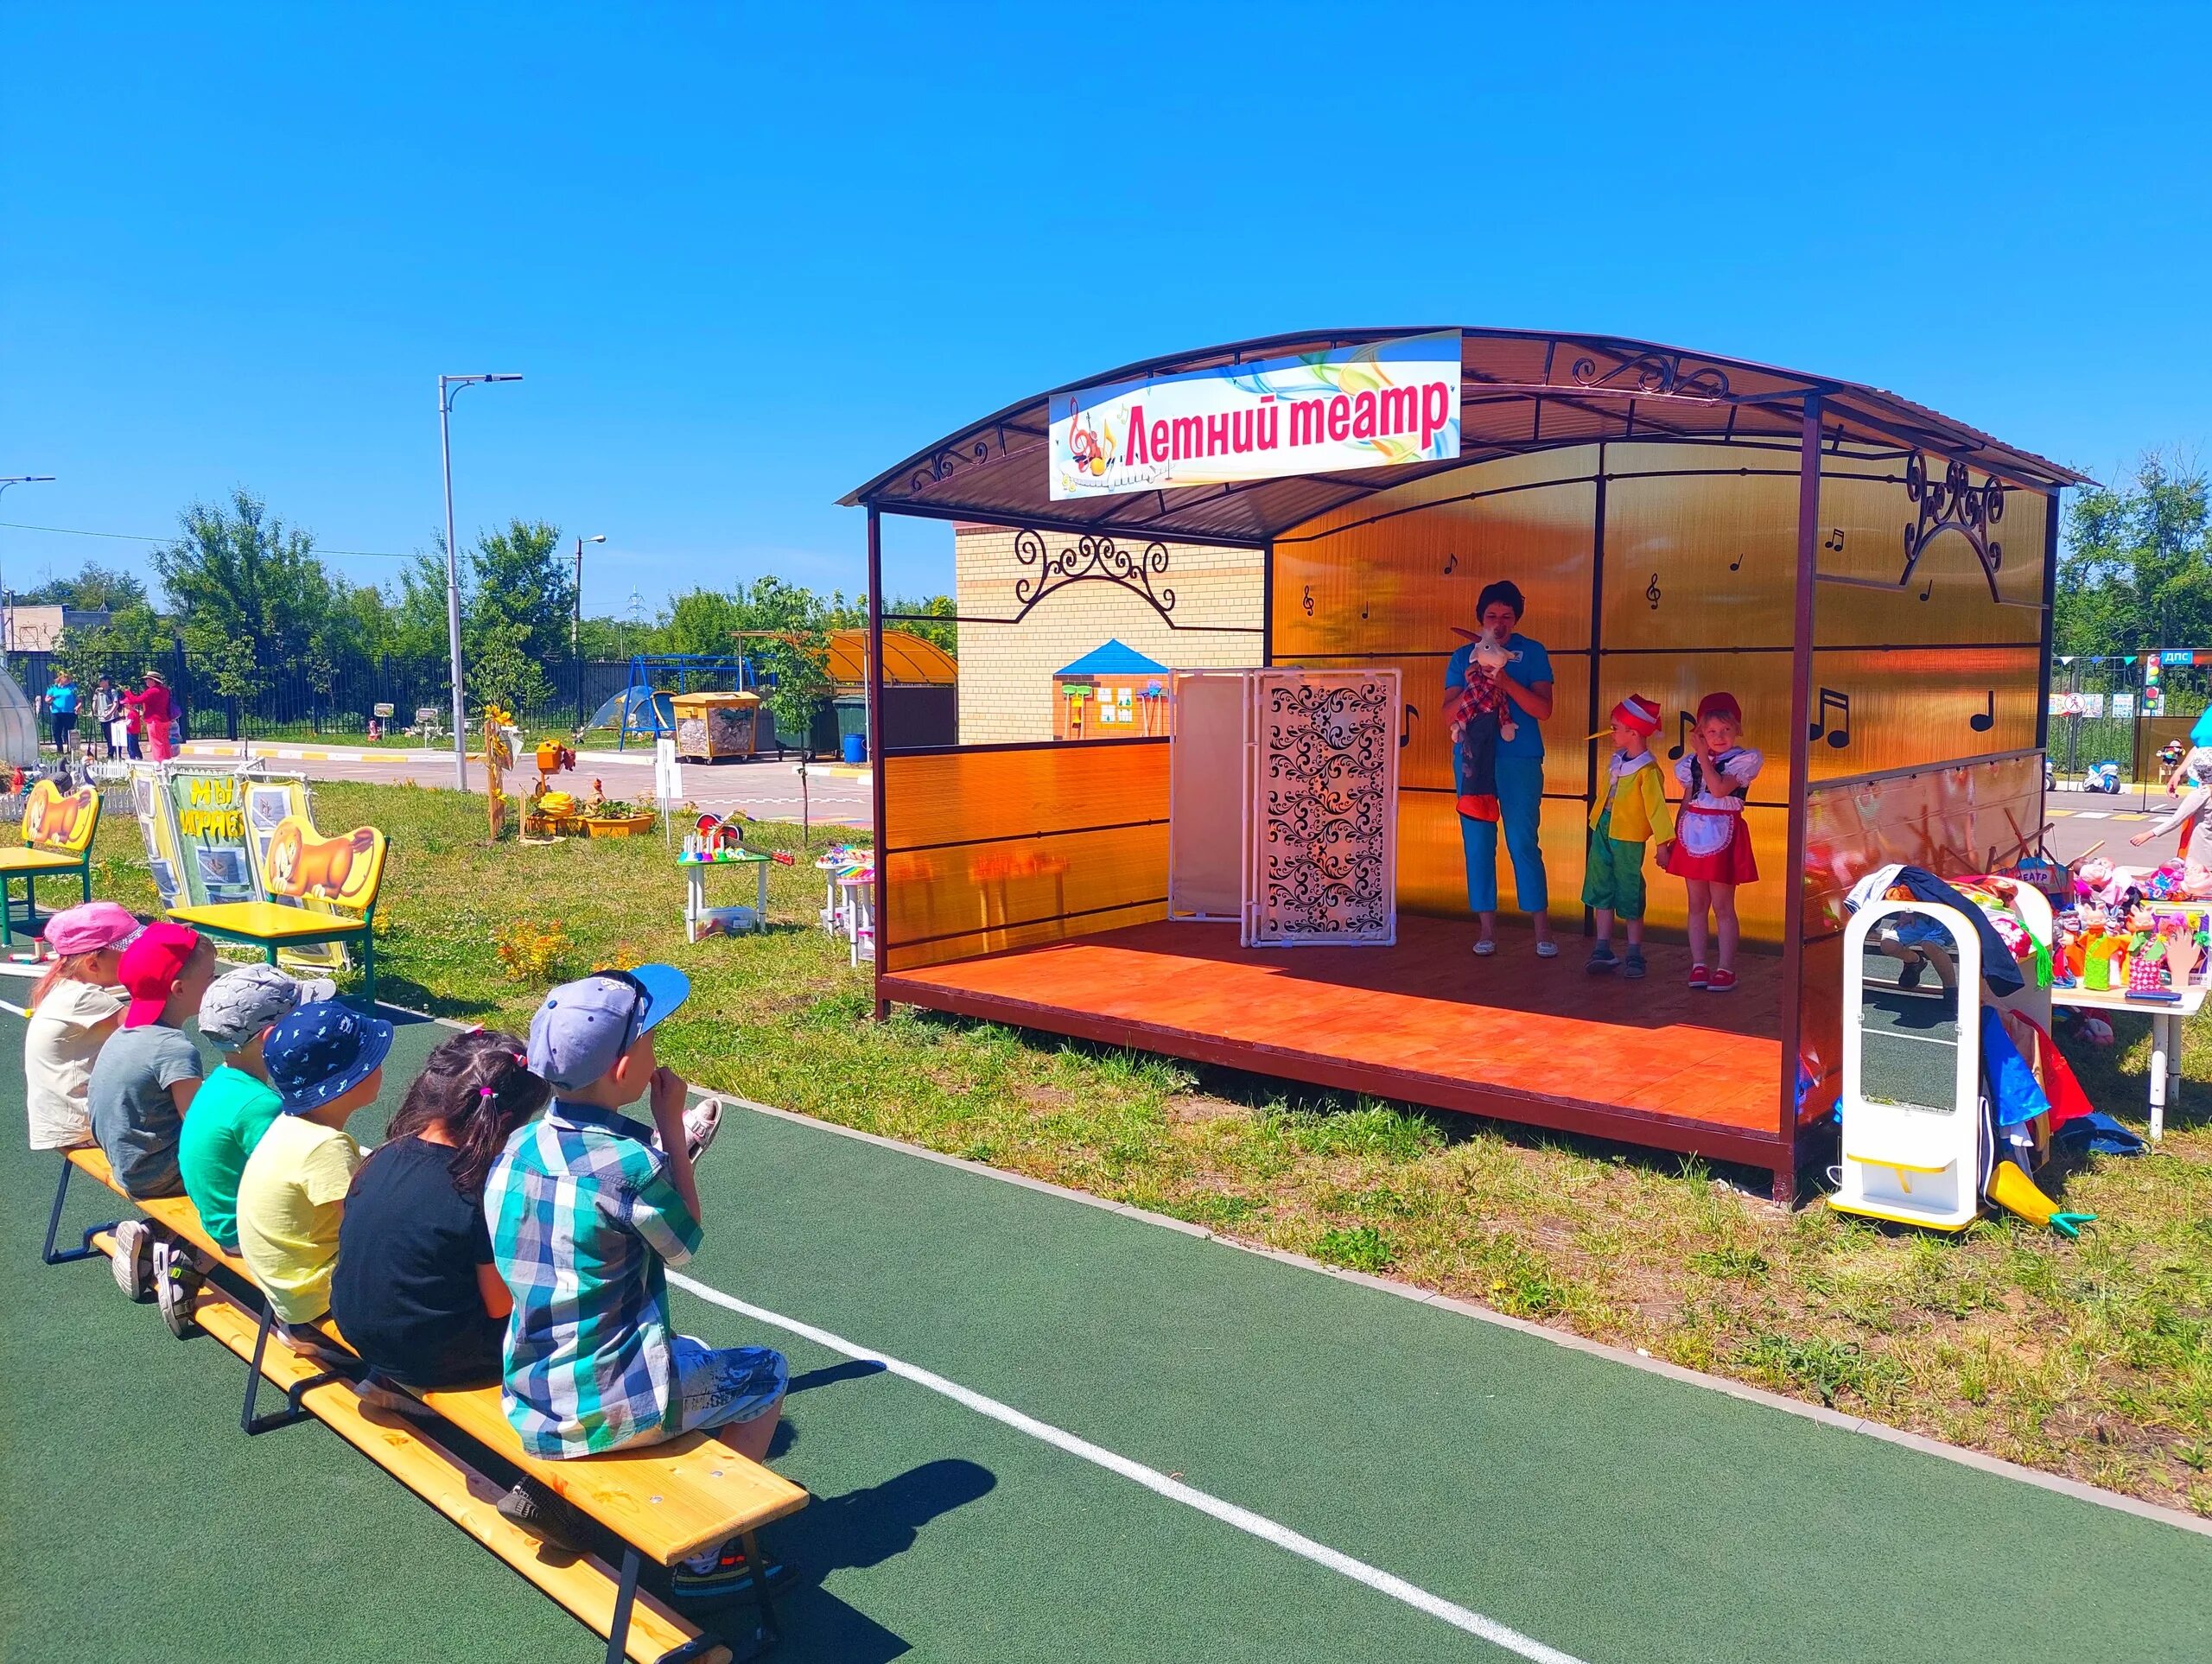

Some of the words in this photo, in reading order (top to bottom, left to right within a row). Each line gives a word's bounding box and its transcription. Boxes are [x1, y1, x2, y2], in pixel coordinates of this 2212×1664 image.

[1125, 396, 1278, 467] Летний
[1290, 381, 1449, 451] театр
[2164, 652, 2189, 663] ДПС
[190, 778, 233, 806] МЫ
